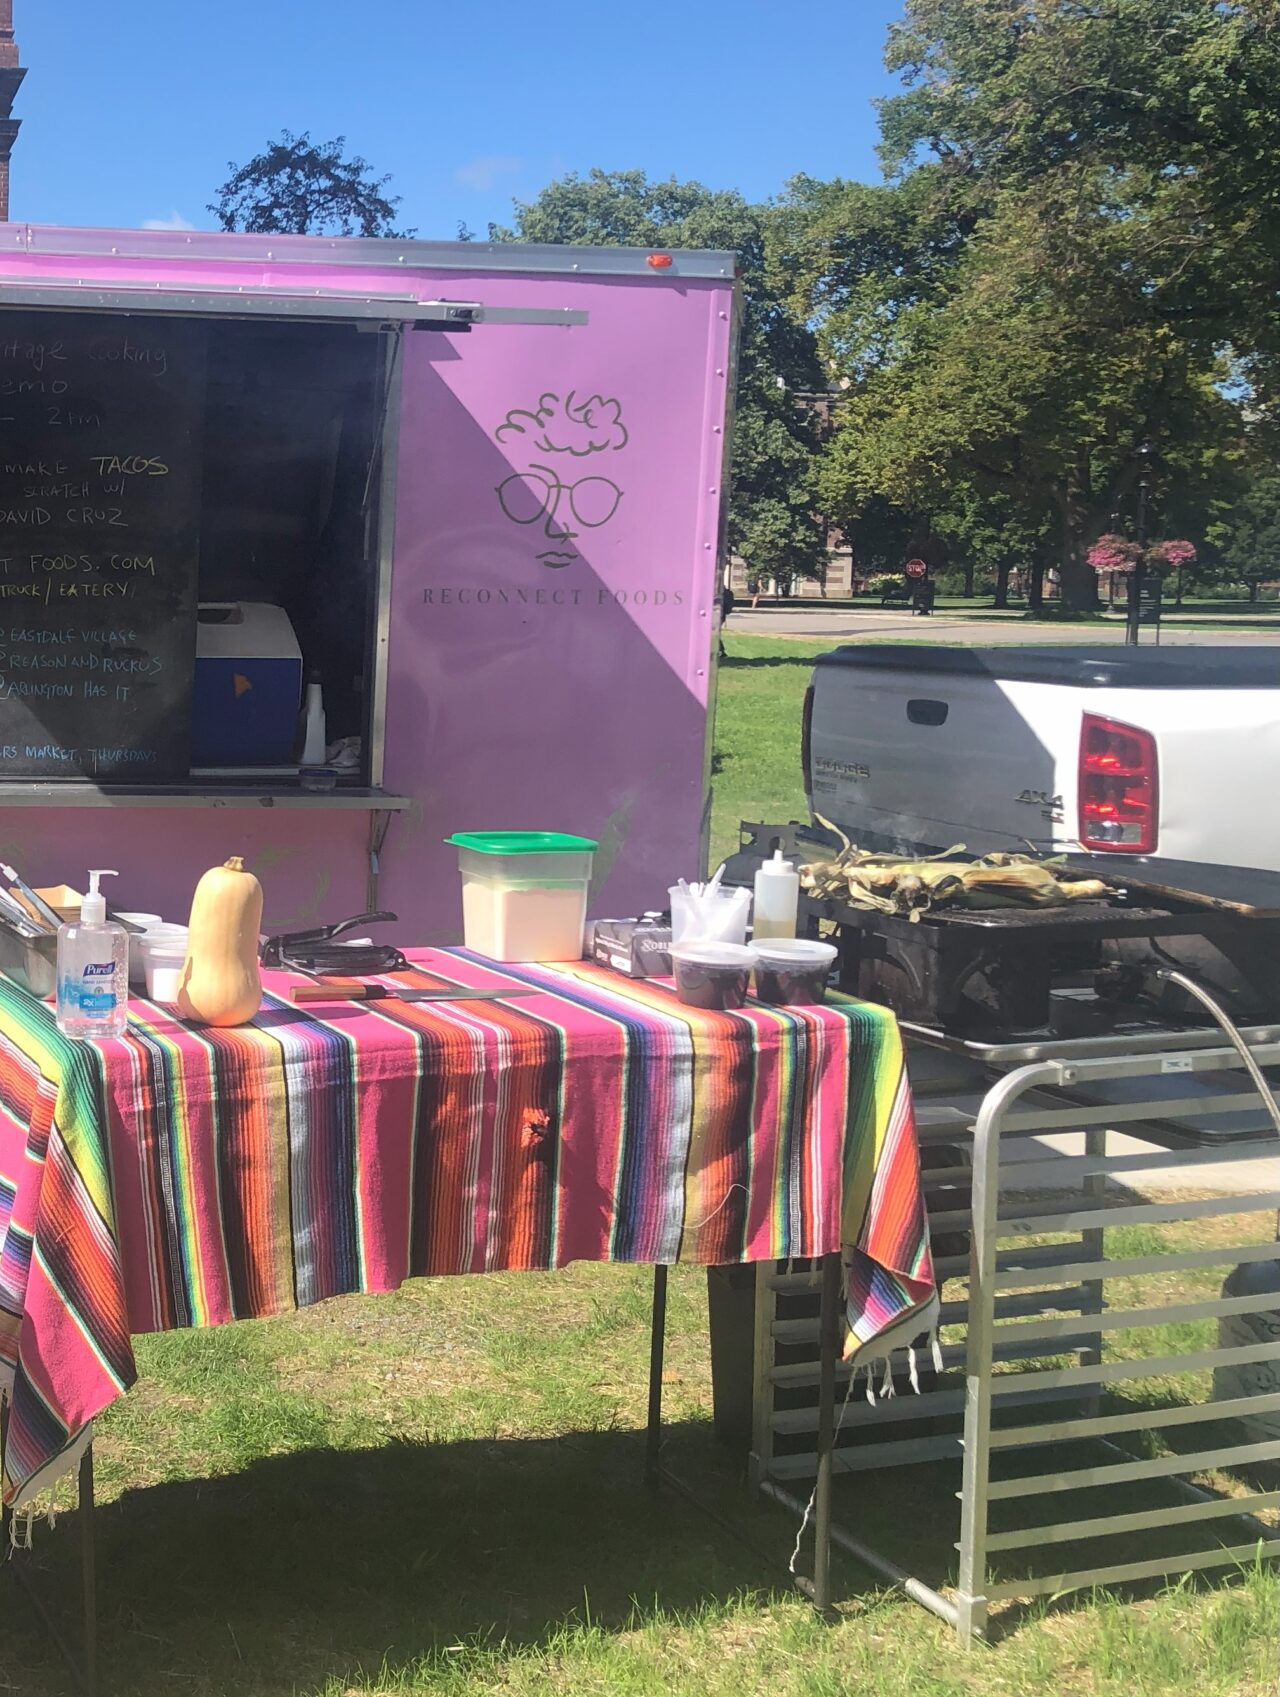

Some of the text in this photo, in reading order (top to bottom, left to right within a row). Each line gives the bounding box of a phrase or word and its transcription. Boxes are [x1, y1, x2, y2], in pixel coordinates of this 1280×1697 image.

[5, 463, 68, 476] MAKE
[89, 455, 169, 476] TACOS
[66, 507, 129, 527] CRUZ
[423, 588, 684, 606] RECONNECT FOODS
[83, 680, 108, 698] HAS
[116, 684, 131, 701] IT
